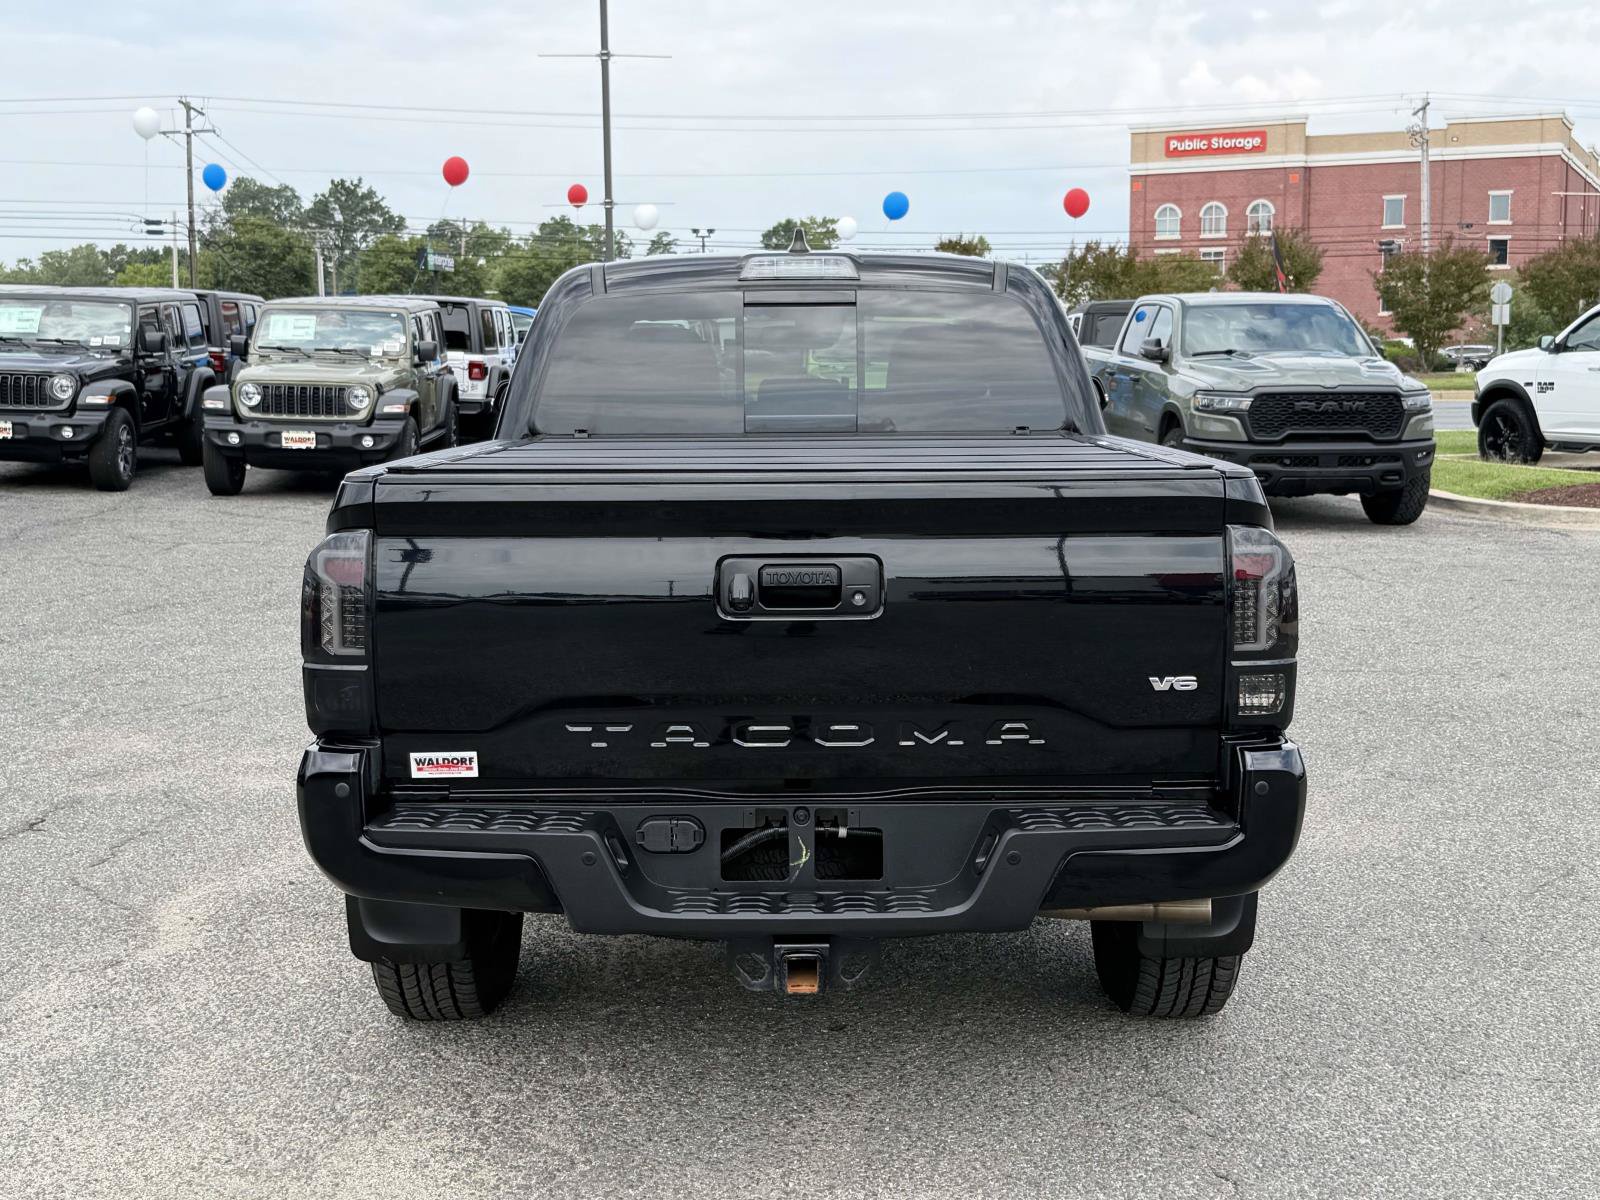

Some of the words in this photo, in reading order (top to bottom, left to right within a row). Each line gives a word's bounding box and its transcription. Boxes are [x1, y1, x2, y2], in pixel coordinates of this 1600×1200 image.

[1169, 138, 1208, 152] Public
[1294, 401, 1366, 412] RAM
[284, 436, 315, 444] WALDORF
[766, 571, 835, 584] TOYOTA
[1148, 675, 1198, 691] V6
[564, 720, 1047, 748] TACOMA
[414, 757, 475, 767] WALDORF
